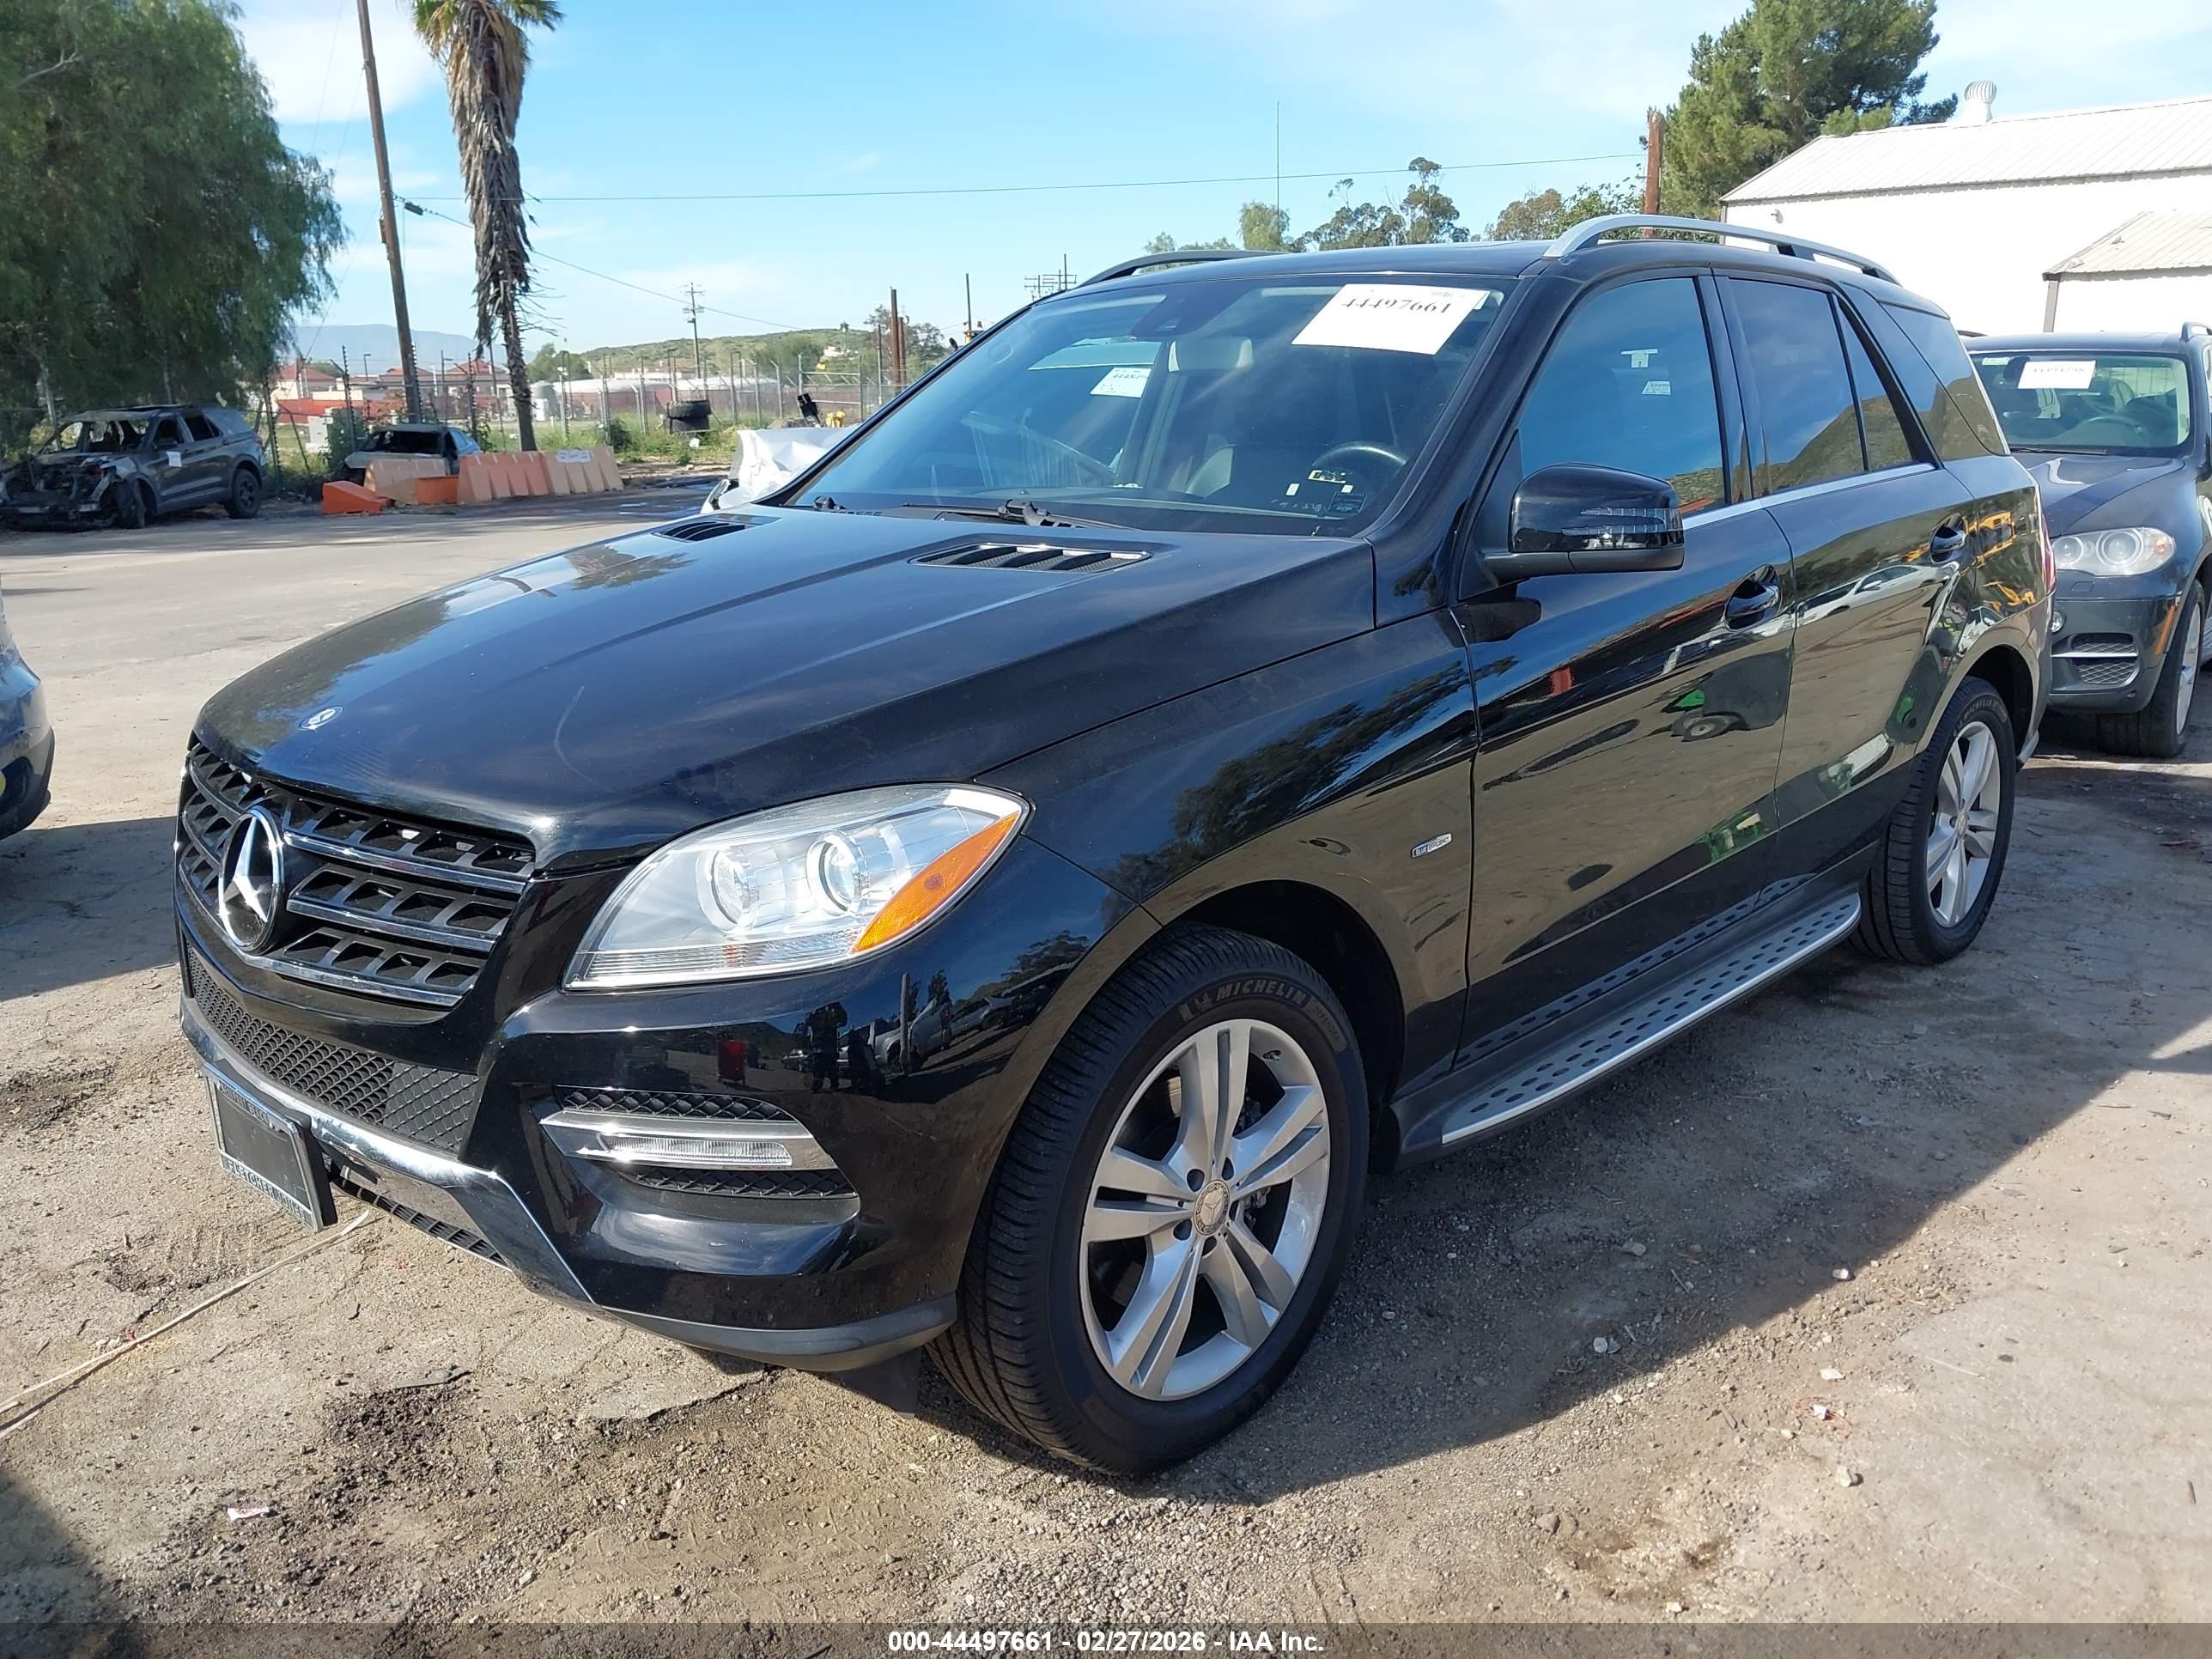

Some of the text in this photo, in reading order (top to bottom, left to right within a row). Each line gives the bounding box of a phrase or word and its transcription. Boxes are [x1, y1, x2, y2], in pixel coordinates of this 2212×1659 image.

[1342, 297, 1452, 313] 44497661
[1215, 979, 1307, 1006] MICHELIN
[228, 1160, 275, 1200] FLETCHER
